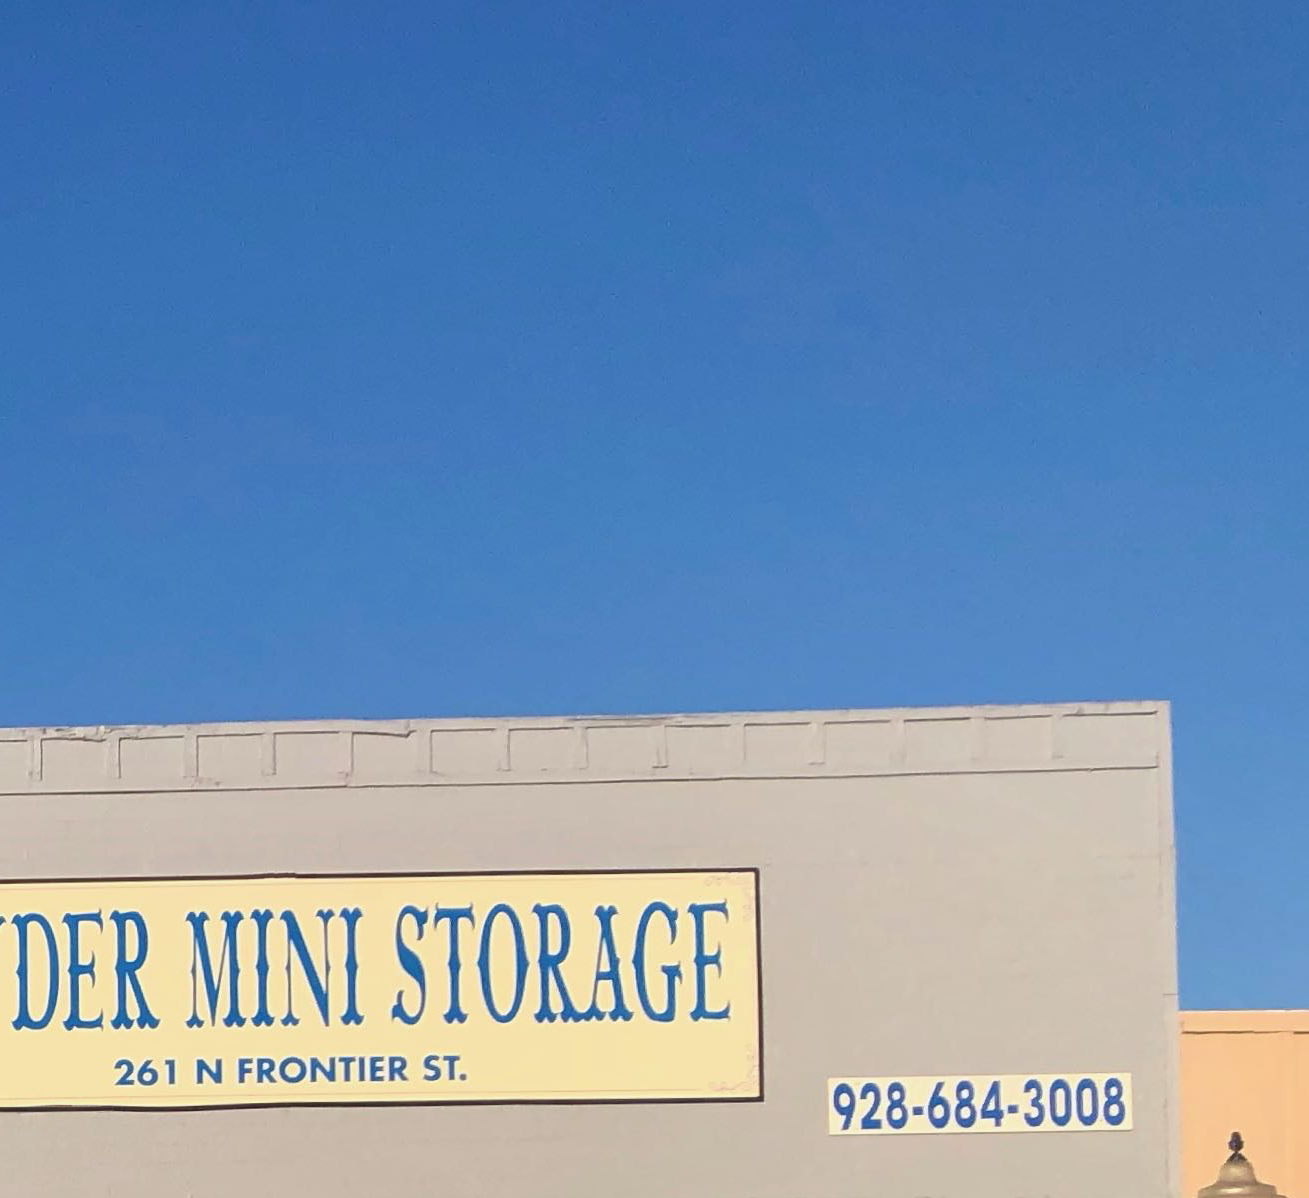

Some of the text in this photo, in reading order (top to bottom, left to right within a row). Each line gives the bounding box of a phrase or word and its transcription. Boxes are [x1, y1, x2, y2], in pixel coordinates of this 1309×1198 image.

[186, 907, 364, 1029] MINI
[390, 901, 730, 1025] STORAGE
[114, 1055, 468, 1086] 261 N FRONTIER ST.
[833, 1076, 1126, 1131] 928-684-3008
